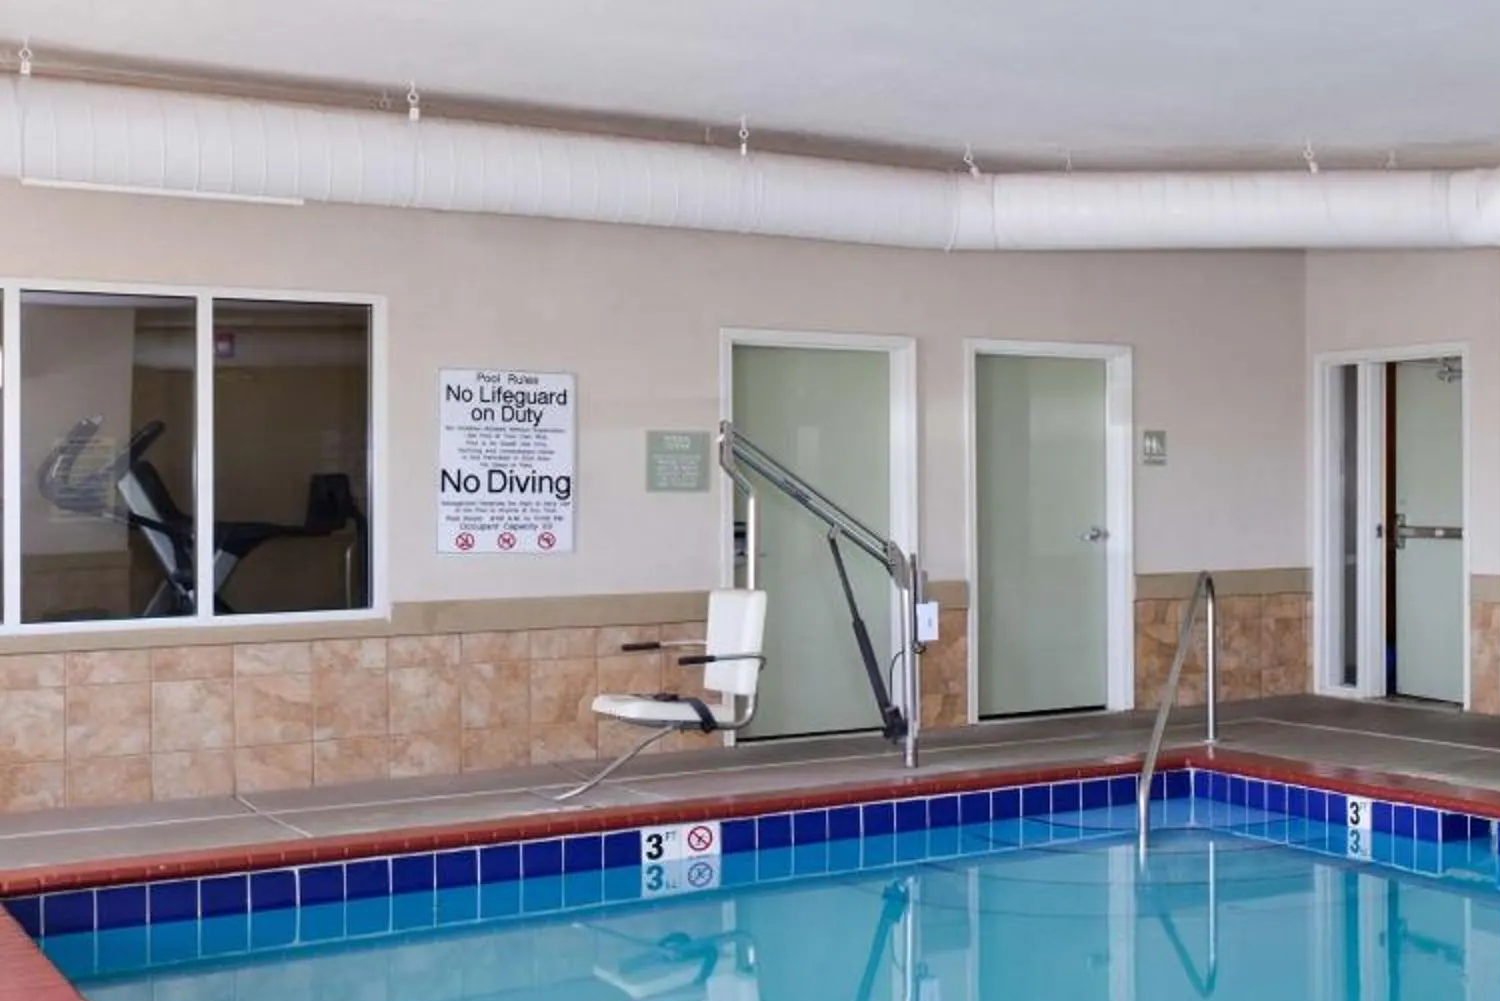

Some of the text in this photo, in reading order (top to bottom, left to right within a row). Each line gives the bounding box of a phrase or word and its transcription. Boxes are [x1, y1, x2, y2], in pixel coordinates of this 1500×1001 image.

[477, 371, 539, 385] Pool Rules
[446, 384, 568, 408] No Lifeguard
[471, 405, 543, 427] on Duty
[441, 468, 571, 500] No Diving
[1350, 801, 1361, 825] 3
[646, 833, 664, 860] 3
